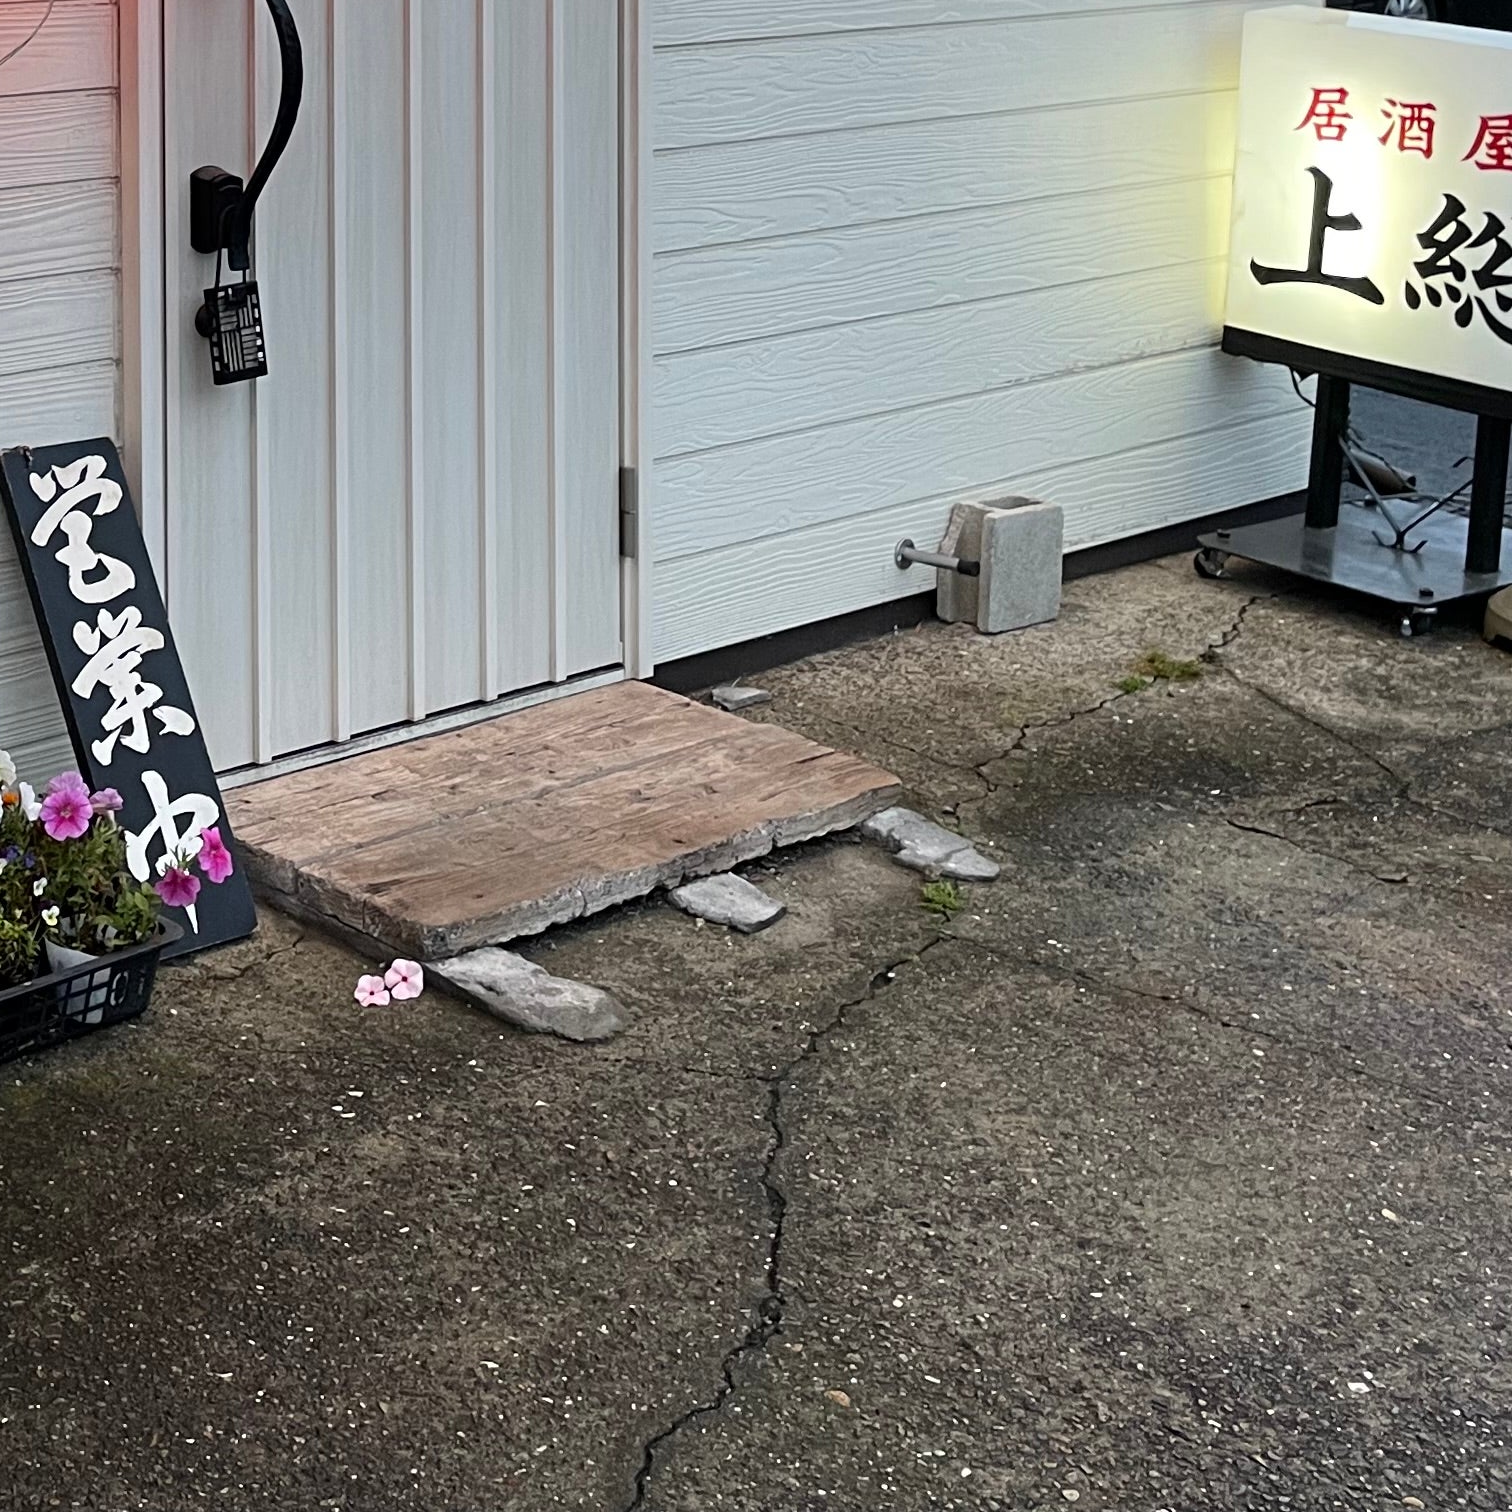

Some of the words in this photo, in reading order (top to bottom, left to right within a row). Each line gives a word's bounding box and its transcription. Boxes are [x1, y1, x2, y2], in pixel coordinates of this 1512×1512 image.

[1295, 87, 1512, 171] 居酒屋
[29, 454, 220, 935] 営業中
